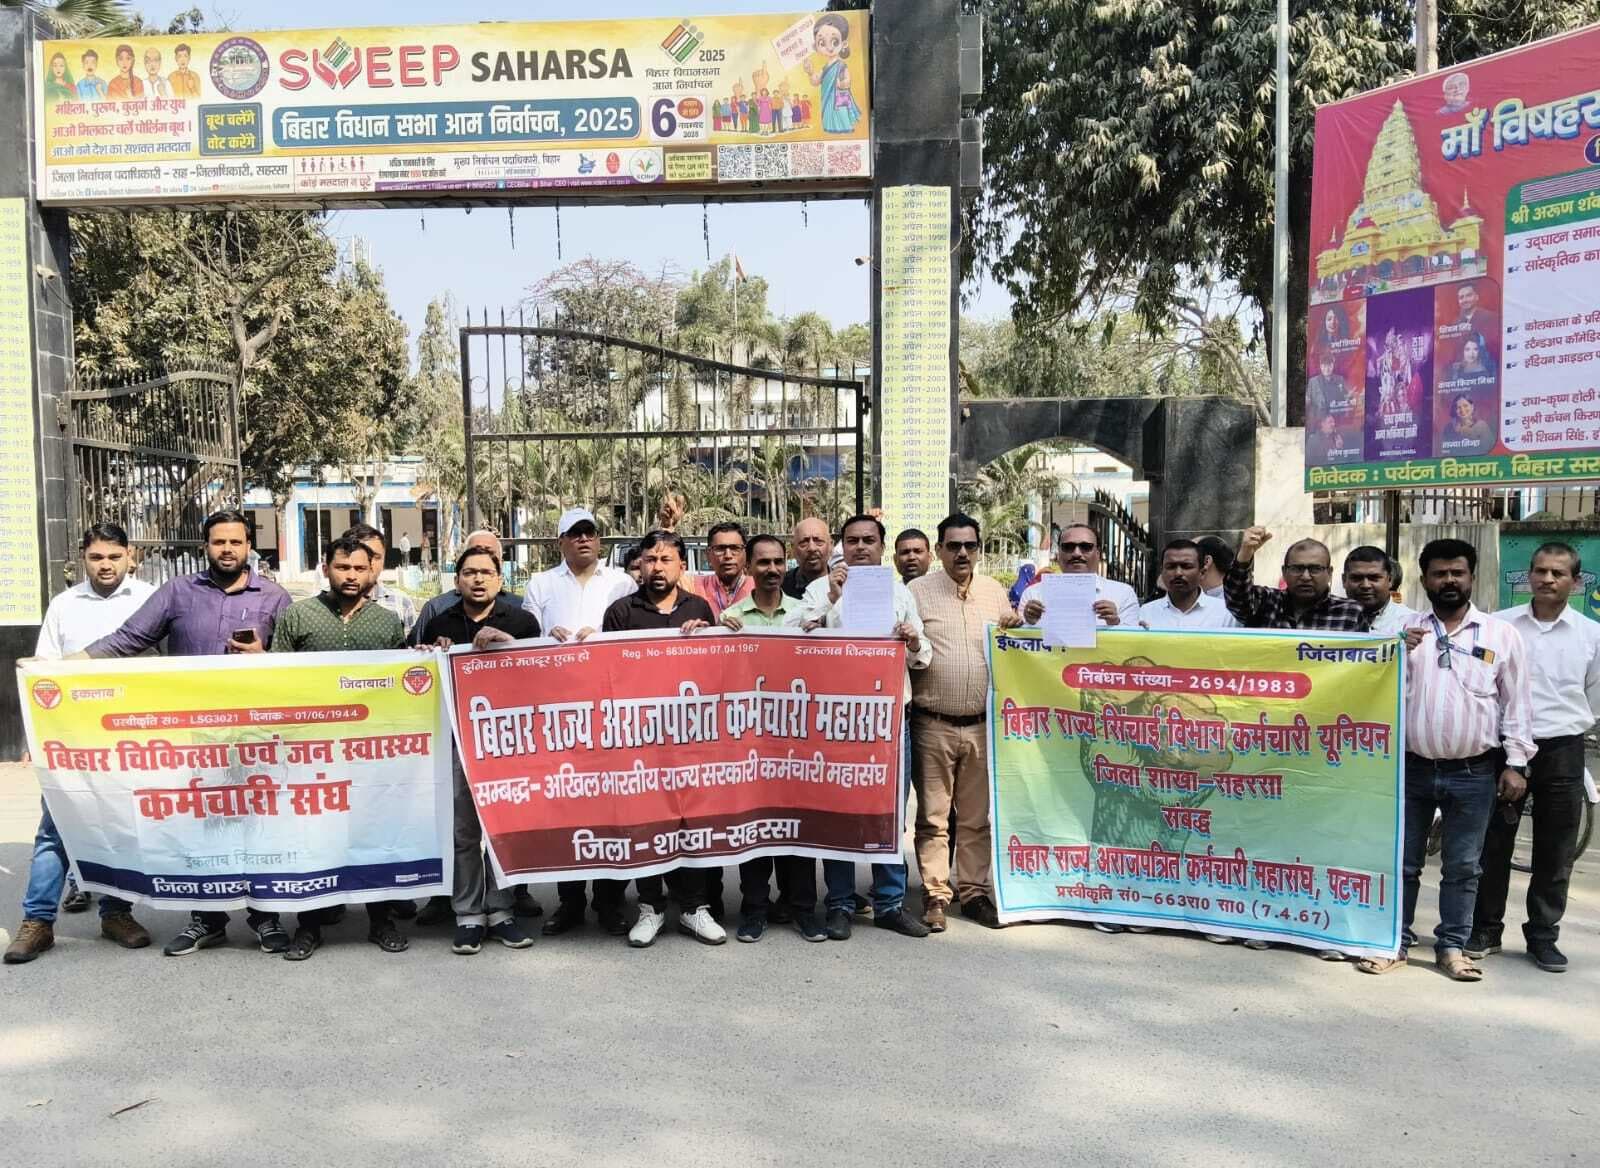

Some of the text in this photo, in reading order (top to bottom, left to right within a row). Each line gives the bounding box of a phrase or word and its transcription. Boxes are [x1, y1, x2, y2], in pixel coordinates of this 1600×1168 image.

[471, 48, 633, 82] SAHARSA
[699, 50, 726, 62] 2025
[206, 112, 225, 130] बूथ
[280, 104, 634, 140] बिहार विधान सभा आम निर्वाचन, 2025
[652, 98, 677, 138] 6
[207, 136, 225, 149] वोट
[52, 171, 75, 183] जिला
[1511, 204, 1530, 224] श्री
[1524, 250, 1581, 272] सांस्कृतिक
[1525, 317, 1569, 331] कोलकाता
[1571, 313, 1582, 325] के
[1544, 411, 1570, 423] कंचन
[1535, 429, 1562, 443] शिवम
[1309, 466, 1369, 486] निवेदक
[1384, 460, 1436, 481] पर्यटन
[1441, 457, 1504, 480] विभाग,
[1511, 453, 1563, 477] बिहार
[500, 655, 514, 668] के
[578, 649, 591, 663] हो
[1077, 667, 1126, 685] निबंधन
[1189, 674, 1296, 696] 2694/1983
[190, 713, 239, 725] LSG3021
[295, 709, 359, 720] 01/06/1944
[469, 675, 896, 760] बिहार राज्य अराजपत्रित कर्मचारी महासंघ
[1001, 697, 1392, 767] बिहार राज्य सिंचाई विभाग कर्मचारी यूनियन
[43, 740, 113, 772] बिहार
[115, 739, 232, 773] चिकित्सा
[234, 733, 281, 766] एवं
[284, 739, 334, 766] जन
[543, 762, 600, 800] अखिल
[600, 759, 660, 796] भारतीय
[661, 763, 700, 793] राज्य
[700, 749, 759, 785] सरकारी
[759, 748, 826, 784] कर्मचारी
[827, 754, 888, 789] महासंघ
[1093, 753, 1141, 789] जिला
[133, 772, 352, 821] कर्मचारी संघ
[1007, 833, 1050, 876] बिहार
[1053, 844, 1091, 876] राज्य
[1096, 839, 1181, 884] अराजपत्रित
[1184, 844, 1249, 891] कर्मचारी
[1327, 868, 1372, 908] पटना
[152, 877, 199, 895] जिला
[271, 875, 339, 895] सहरसा
[1055, 881, 1113, 904] प्रस्वीकृति
